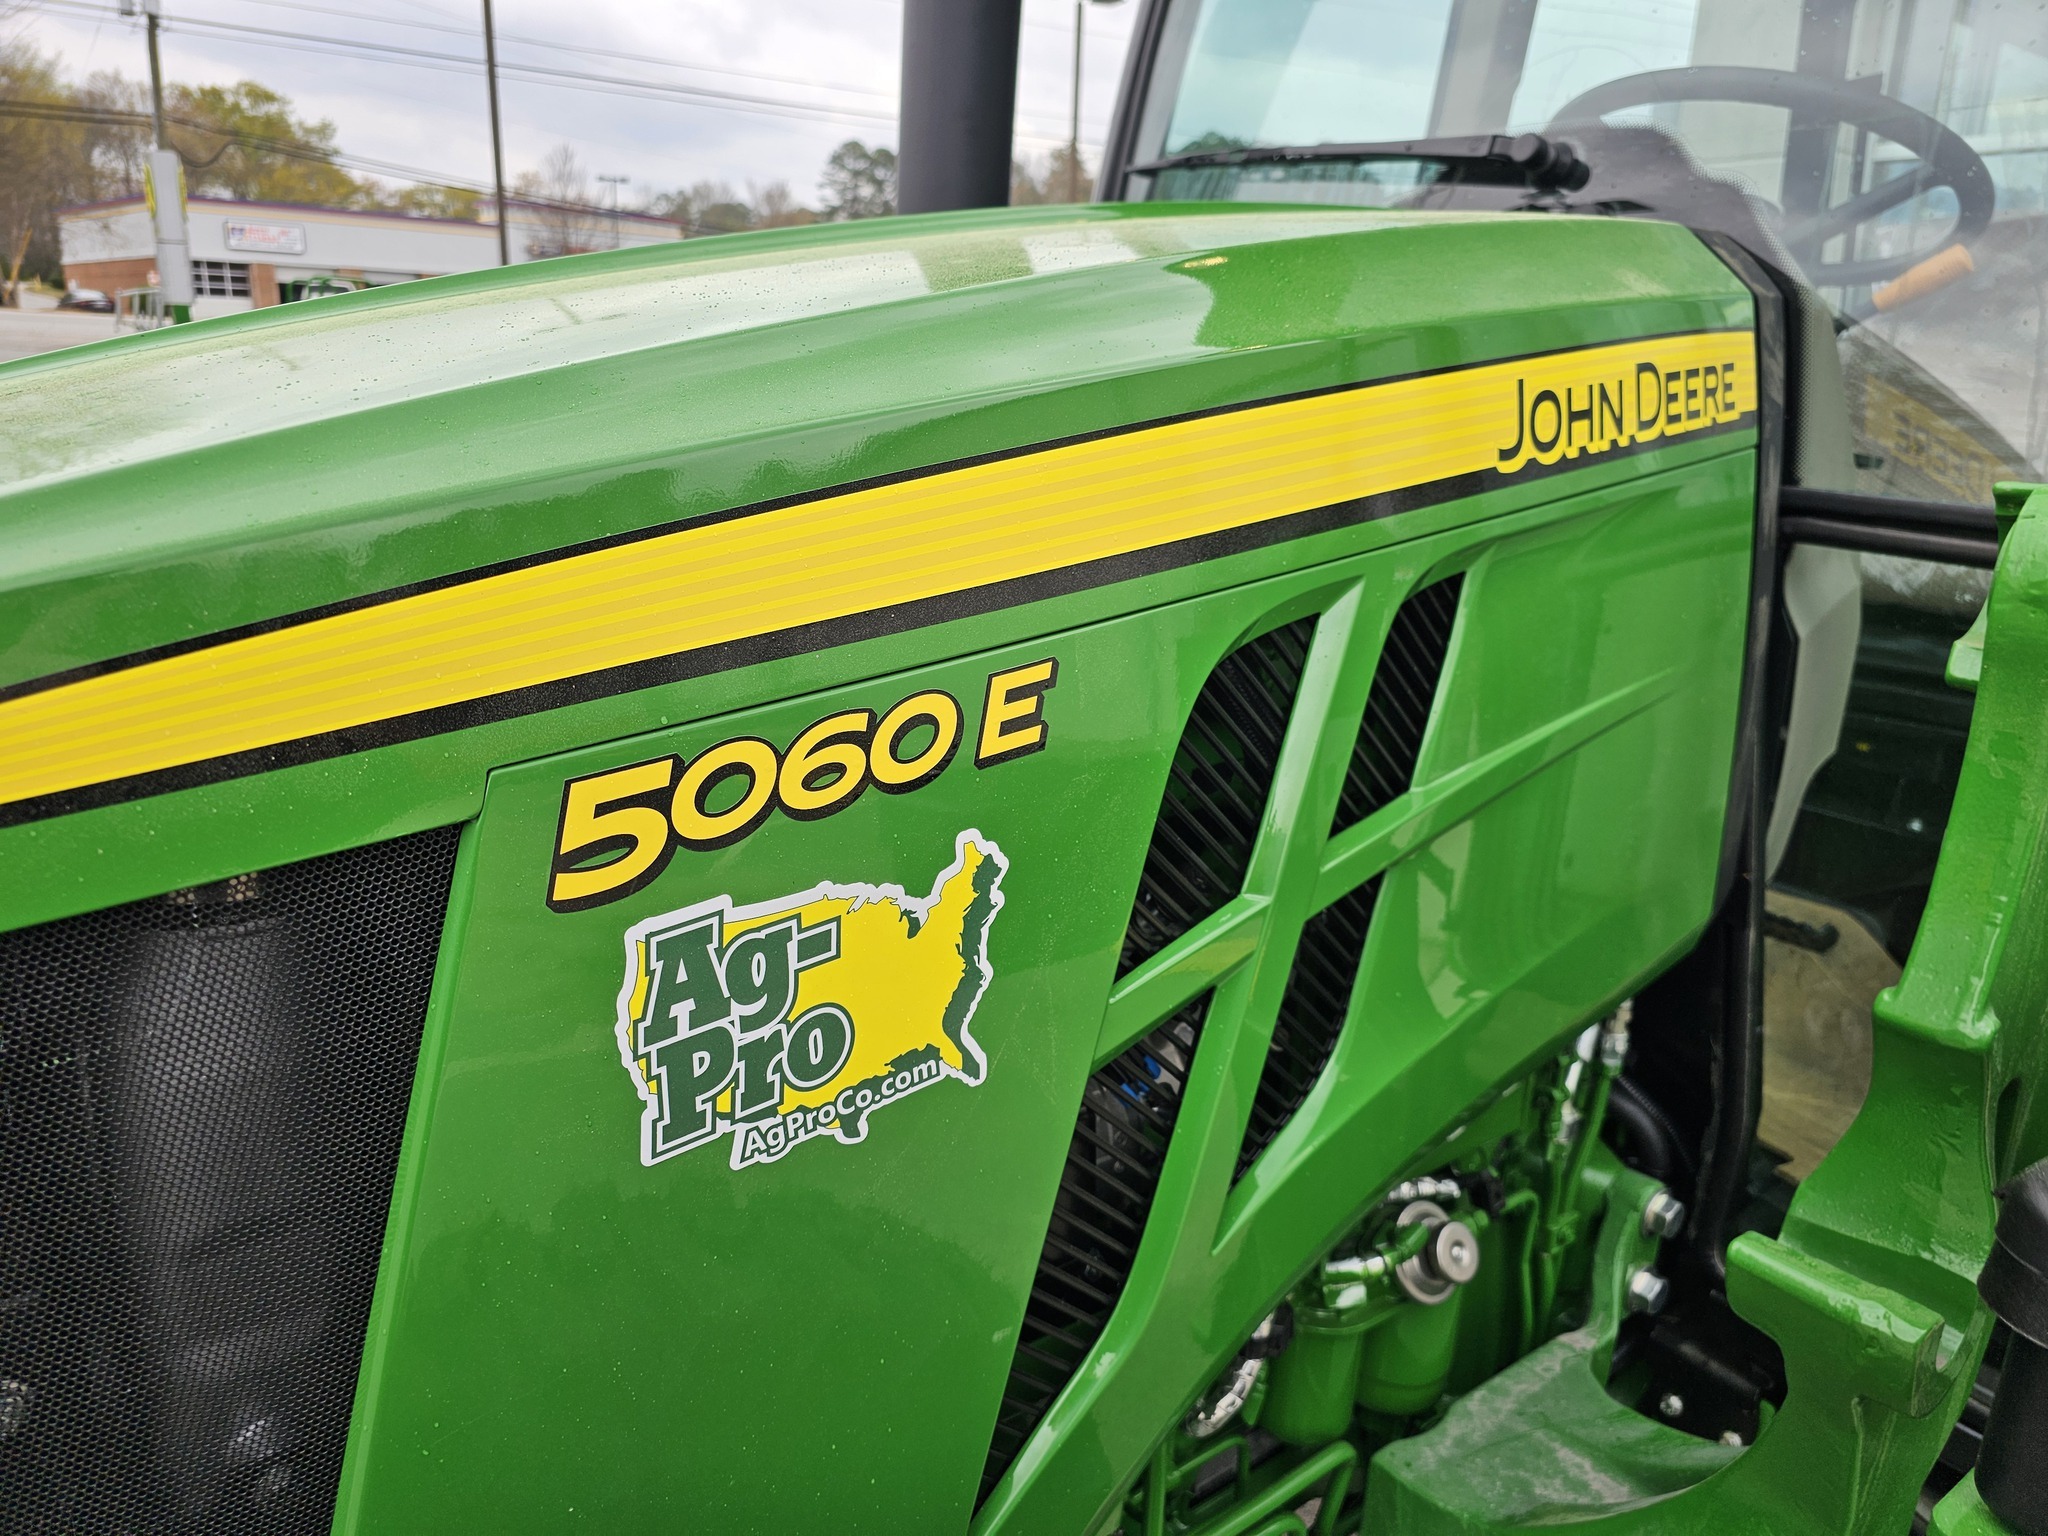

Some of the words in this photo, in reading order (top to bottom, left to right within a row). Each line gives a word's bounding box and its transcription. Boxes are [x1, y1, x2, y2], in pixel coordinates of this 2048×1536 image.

[1498, 378, 1624, 461] JOHN
[1635, 361, 1737, 433] DEERE
[548, 689, 963, 909] 5060
[976, 658, 1057, 766] E
[640, 911, 840, 1048] Ag-
[649, 1009, 853, 1156] Pro
[743, 1057, 939, 1160] AgProCo.com
